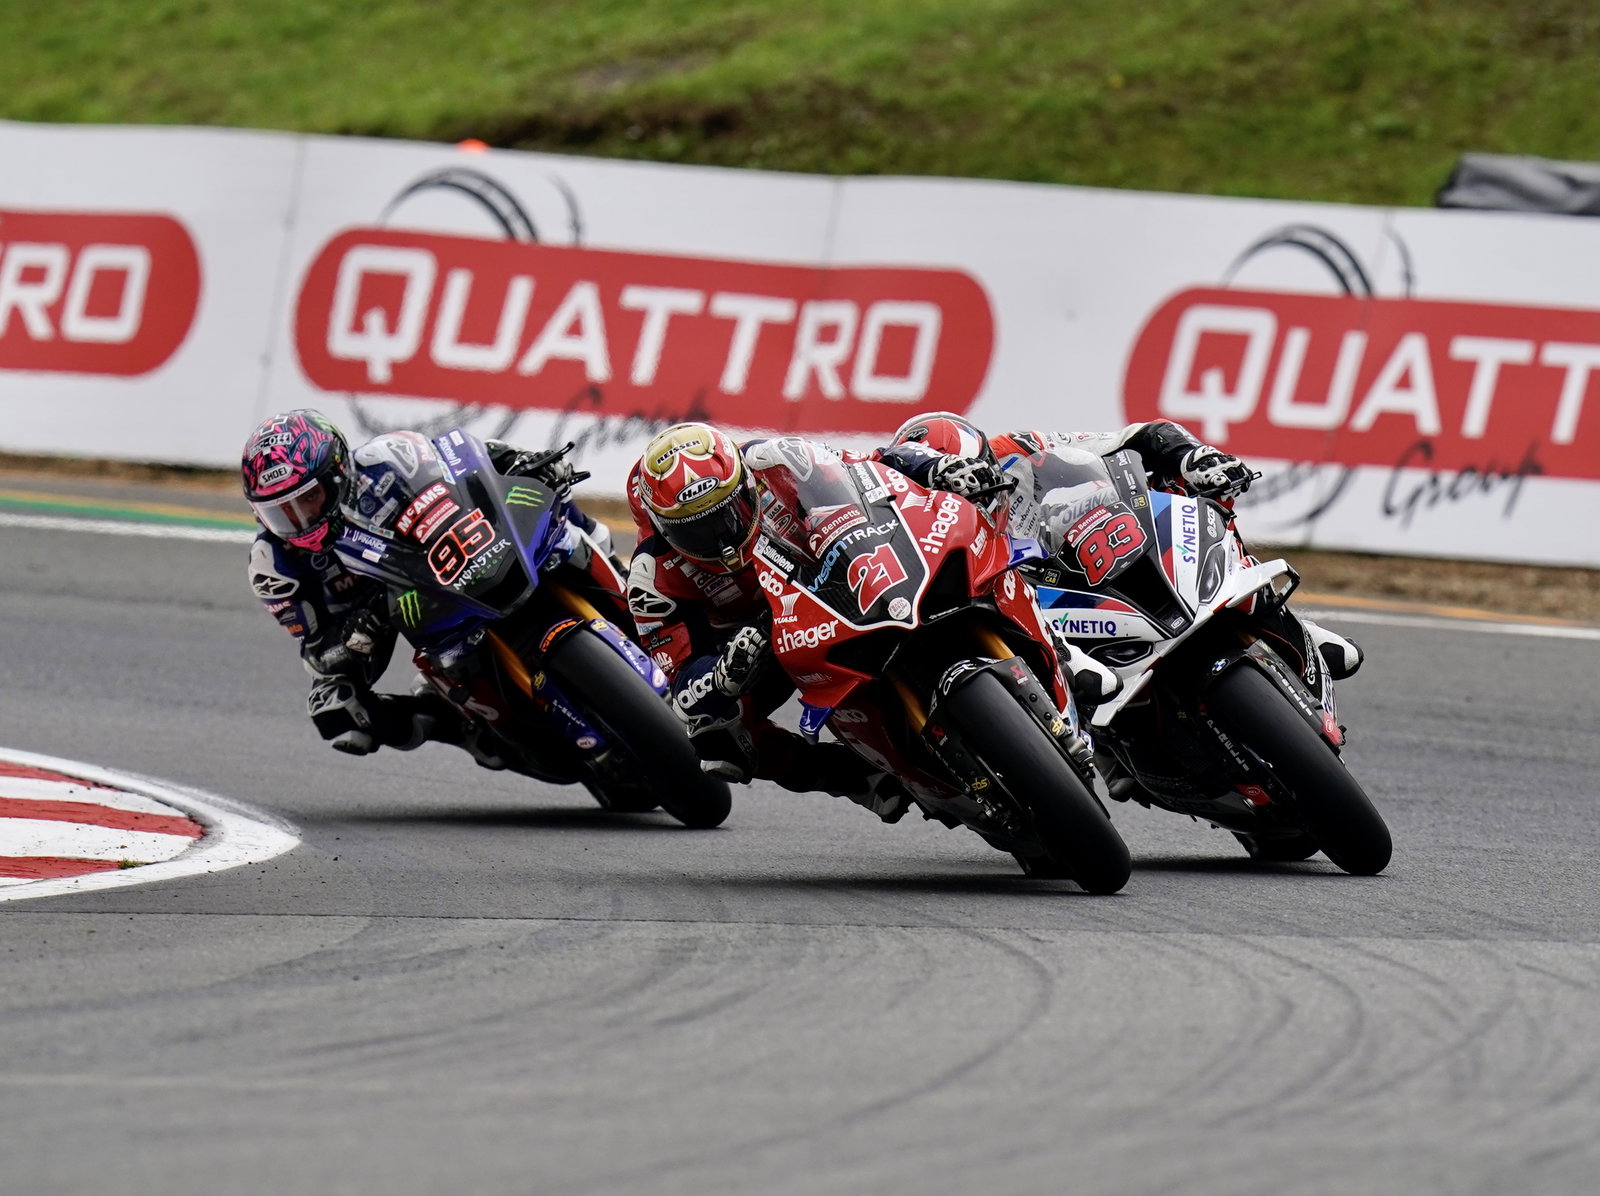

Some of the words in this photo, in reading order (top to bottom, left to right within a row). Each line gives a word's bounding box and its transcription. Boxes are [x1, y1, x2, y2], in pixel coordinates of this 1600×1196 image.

[0, 242, 151, 343] RO
[327, 244, 941, 403] QUATTRO
[1159, 305, 1600, 445] QUATT
[261, 466, 288, 483] SHOEI
[656, 439, 700, 465] REISSER
[397, 483, 447, 533] McAMS
[682, 479, 713, 501] HJC
[1380, 440, 1543, 530] Group
[426, 501, 454, 525] Bennetts
[767, 503, 784, 520] UASA
[821, 509, 860, 535] Bennetts
[1078, 507, 1106, 530] Bennetts
[1182, 504, 1197, 564] SYNETIQ
[428, 508, 495, 585] 95
[453, 538, 512, 590] MONSTER
[763, 545, 795, 573] Silkolene
[1077, 513, 1147, 589] 83
[847, 542, 909, 616] 21
[774, 615, 798, 625] YUASA
[1052, 613, 1117, 637] SYNETIQ
[1206, 719, 1250, 772] PIRELLI
